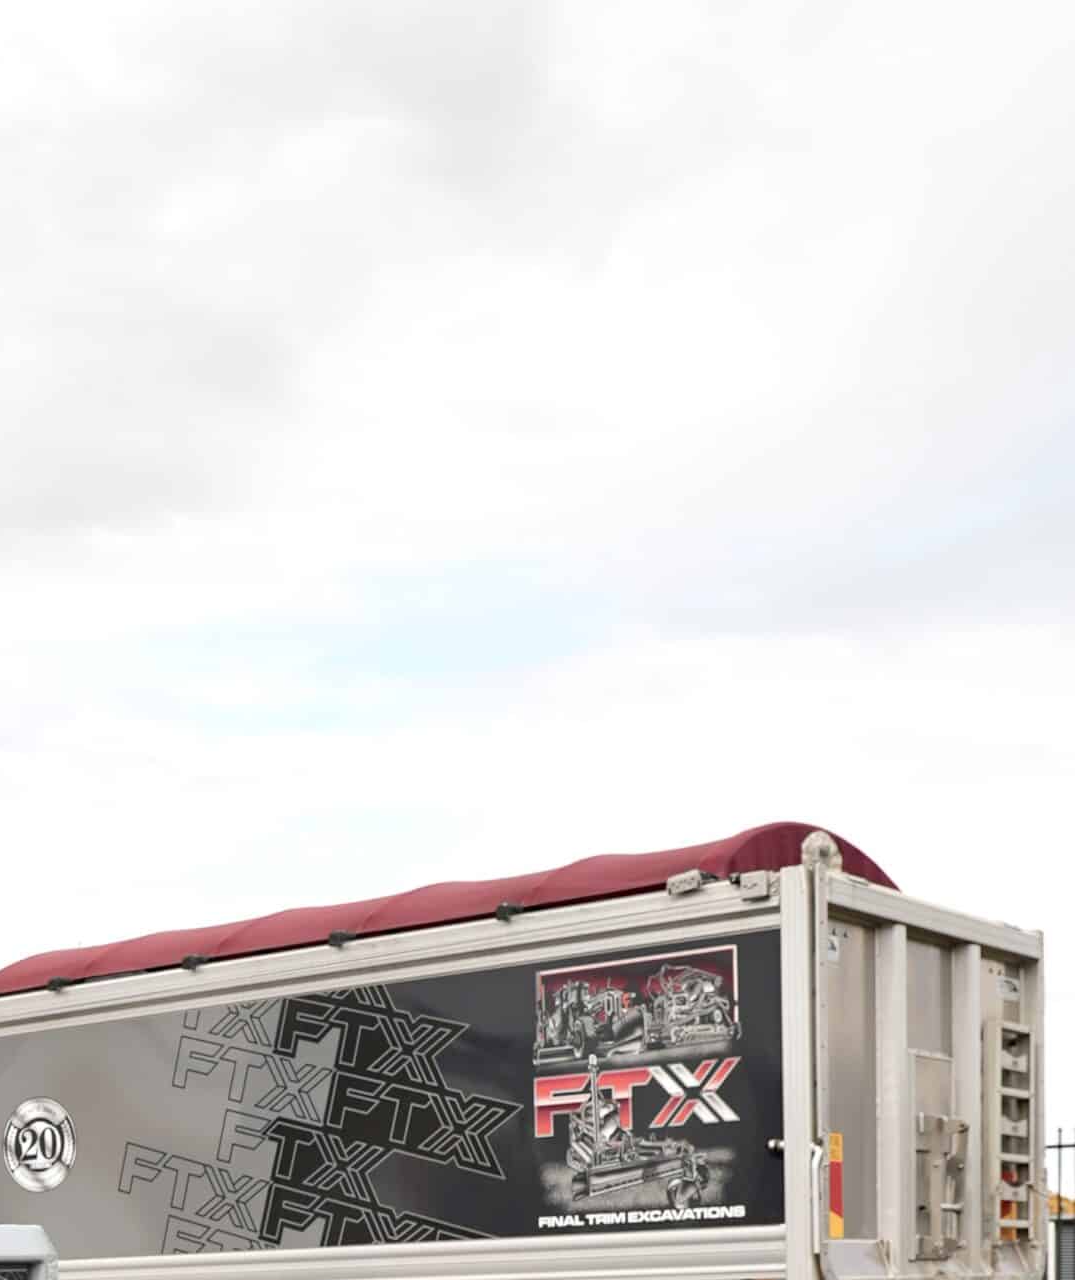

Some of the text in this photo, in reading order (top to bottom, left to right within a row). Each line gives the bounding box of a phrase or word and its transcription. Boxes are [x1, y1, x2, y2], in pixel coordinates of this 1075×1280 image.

[172, 1035, 333, 1123] FTX
[276, 998, 452, 1087] FTX
[326, 1071, 504, 1167] FTX
[534, 1056, 741, 1137] FTX
[20, 1127, 57, 1161] 20
[118, 1141, 269, 1232] FTX
[217, 1109, 384, 1201] FTX
[538, 1205, 746, 1228] FINAL TRIM EXCAVATIONS
